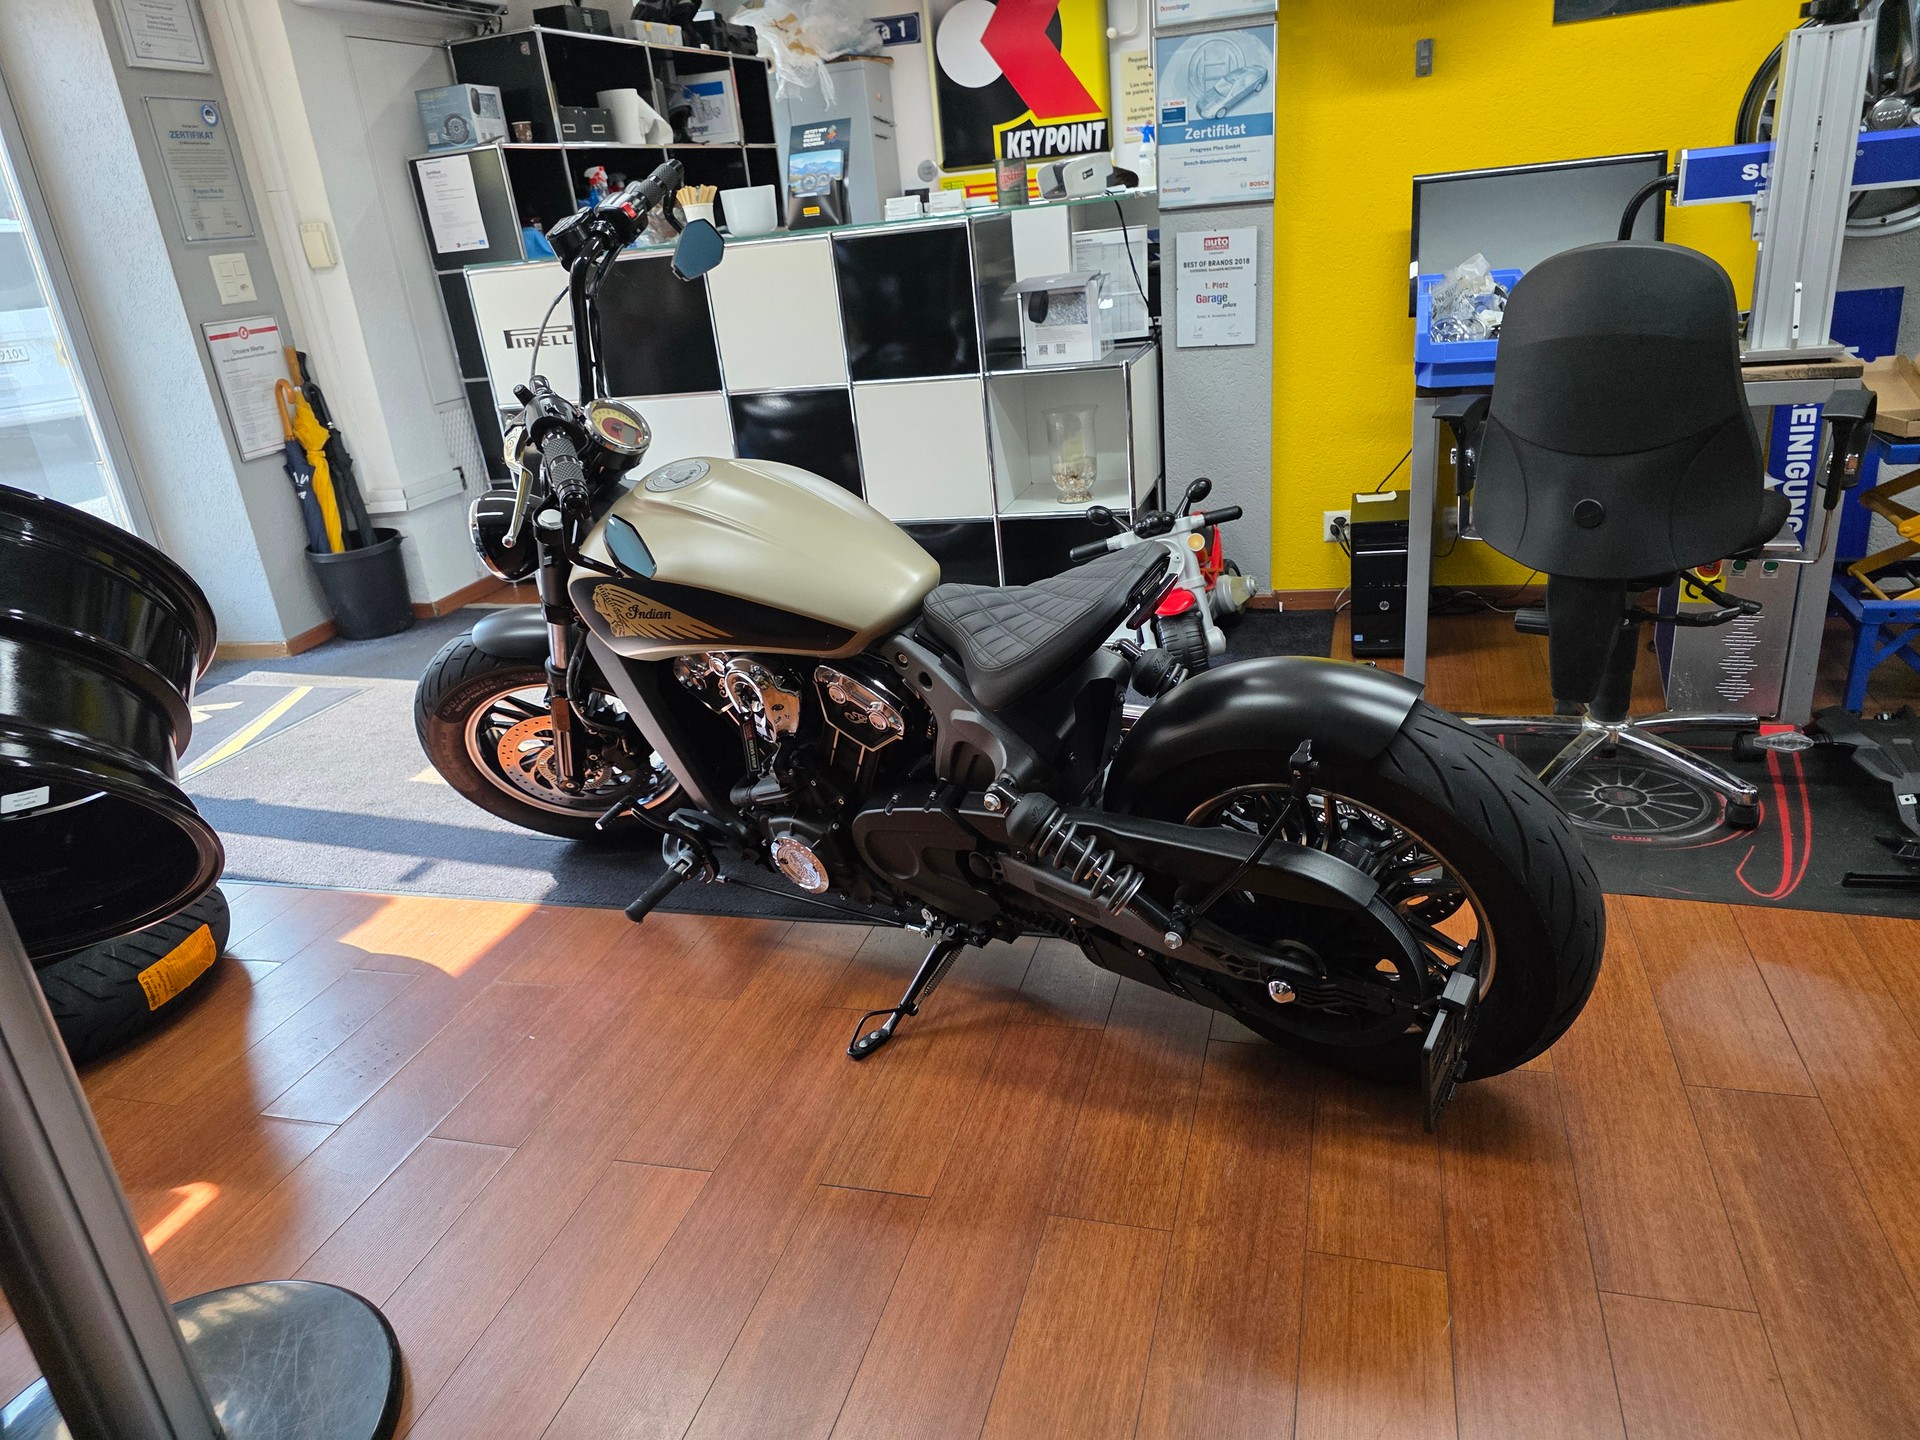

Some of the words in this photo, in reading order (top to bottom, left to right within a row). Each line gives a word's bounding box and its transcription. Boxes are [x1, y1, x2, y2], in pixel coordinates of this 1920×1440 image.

[897, 20, 906, 38] 1
[169, 130, 214, 140] ZERTIFIKAT
[1184, 123, 1247, 140] Zertifikat
[1006, 121, 1106, 159] KEYPOINT
[1190, 146, 1212, 154] Progress
[1204, 237, 1229, 247] auto
[1208, 259, 1234, 267] BRANDS
[1205, 282, 1211, 290] 1.
[1196, 293, 1228, 305] Garage
[503, 325, 574, 349] PIRELL
[1782, 403, 1818, 533] EINIGUNG
[625, 604, 672, 620] Indian
